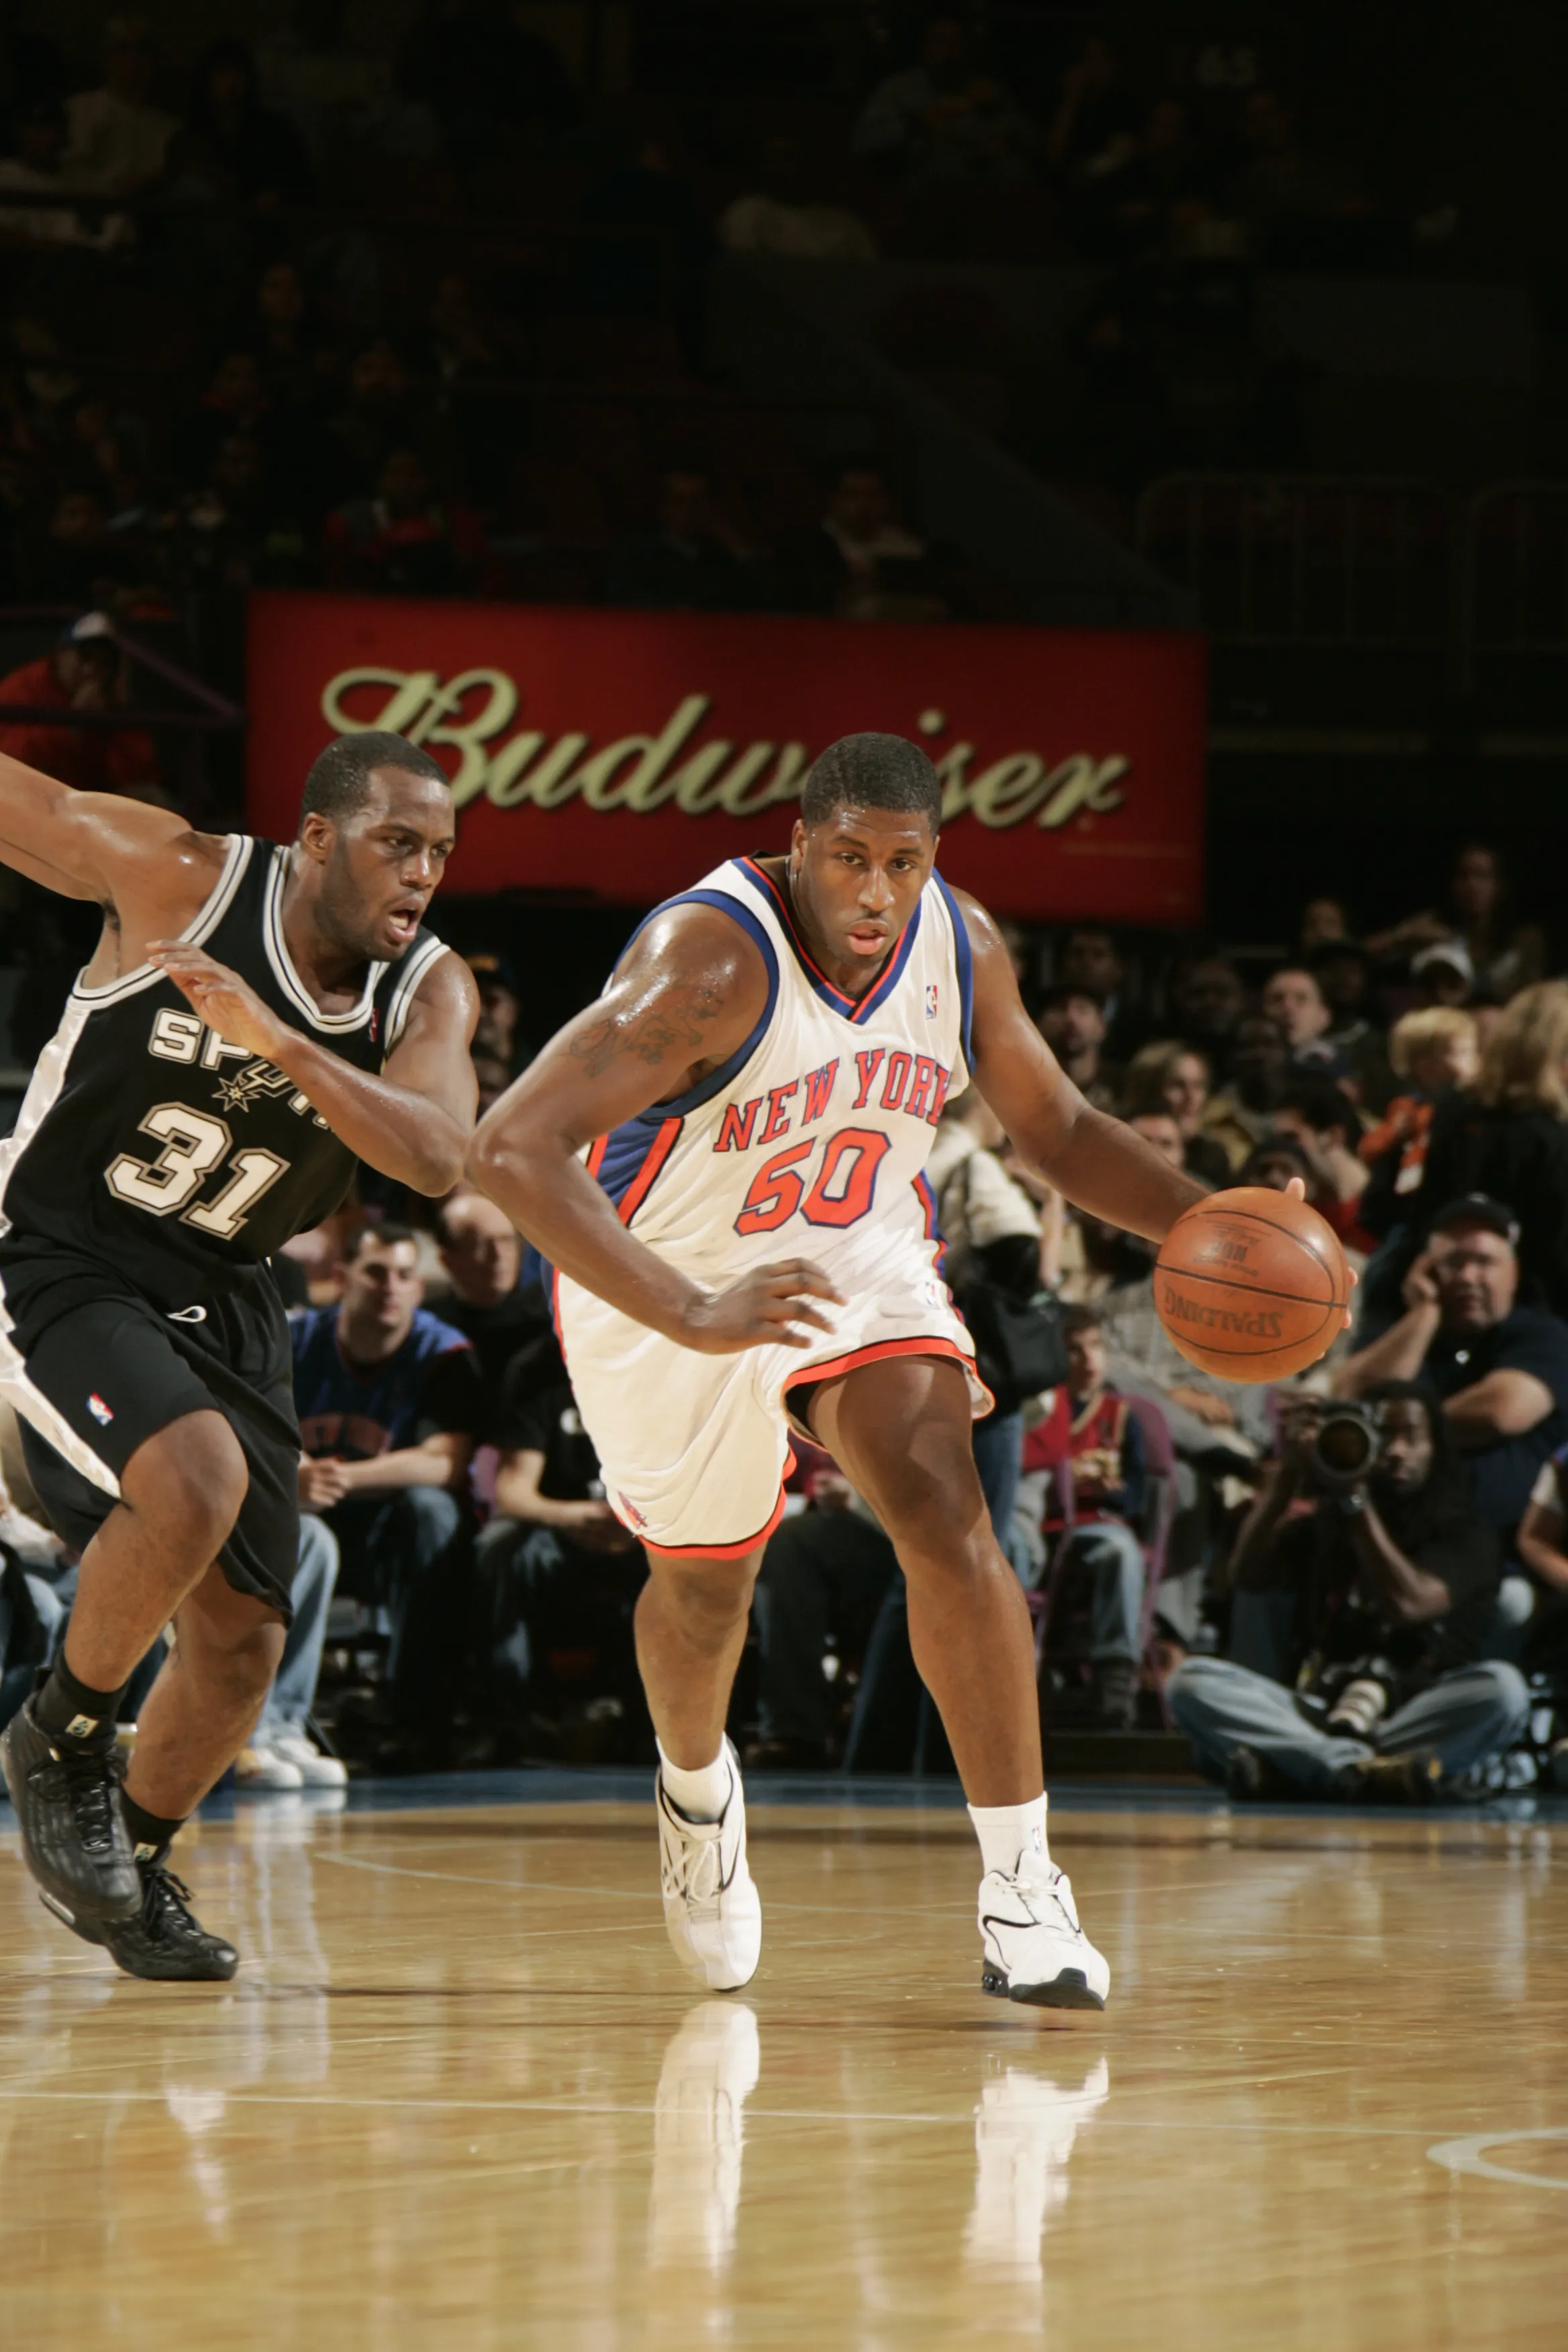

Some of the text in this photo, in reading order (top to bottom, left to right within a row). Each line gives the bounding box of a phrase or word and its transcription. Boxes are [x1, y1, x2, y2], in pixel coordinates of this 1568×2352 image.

[321, 667, 1130, 828] Budwser
[713, 1048, 952, 1153] NEW YORK
[103, 1101, 291, 1240] 31
[733, 1127, 891, 1237] 50
[1163, 1281, 1284, 1339] SPALDING
